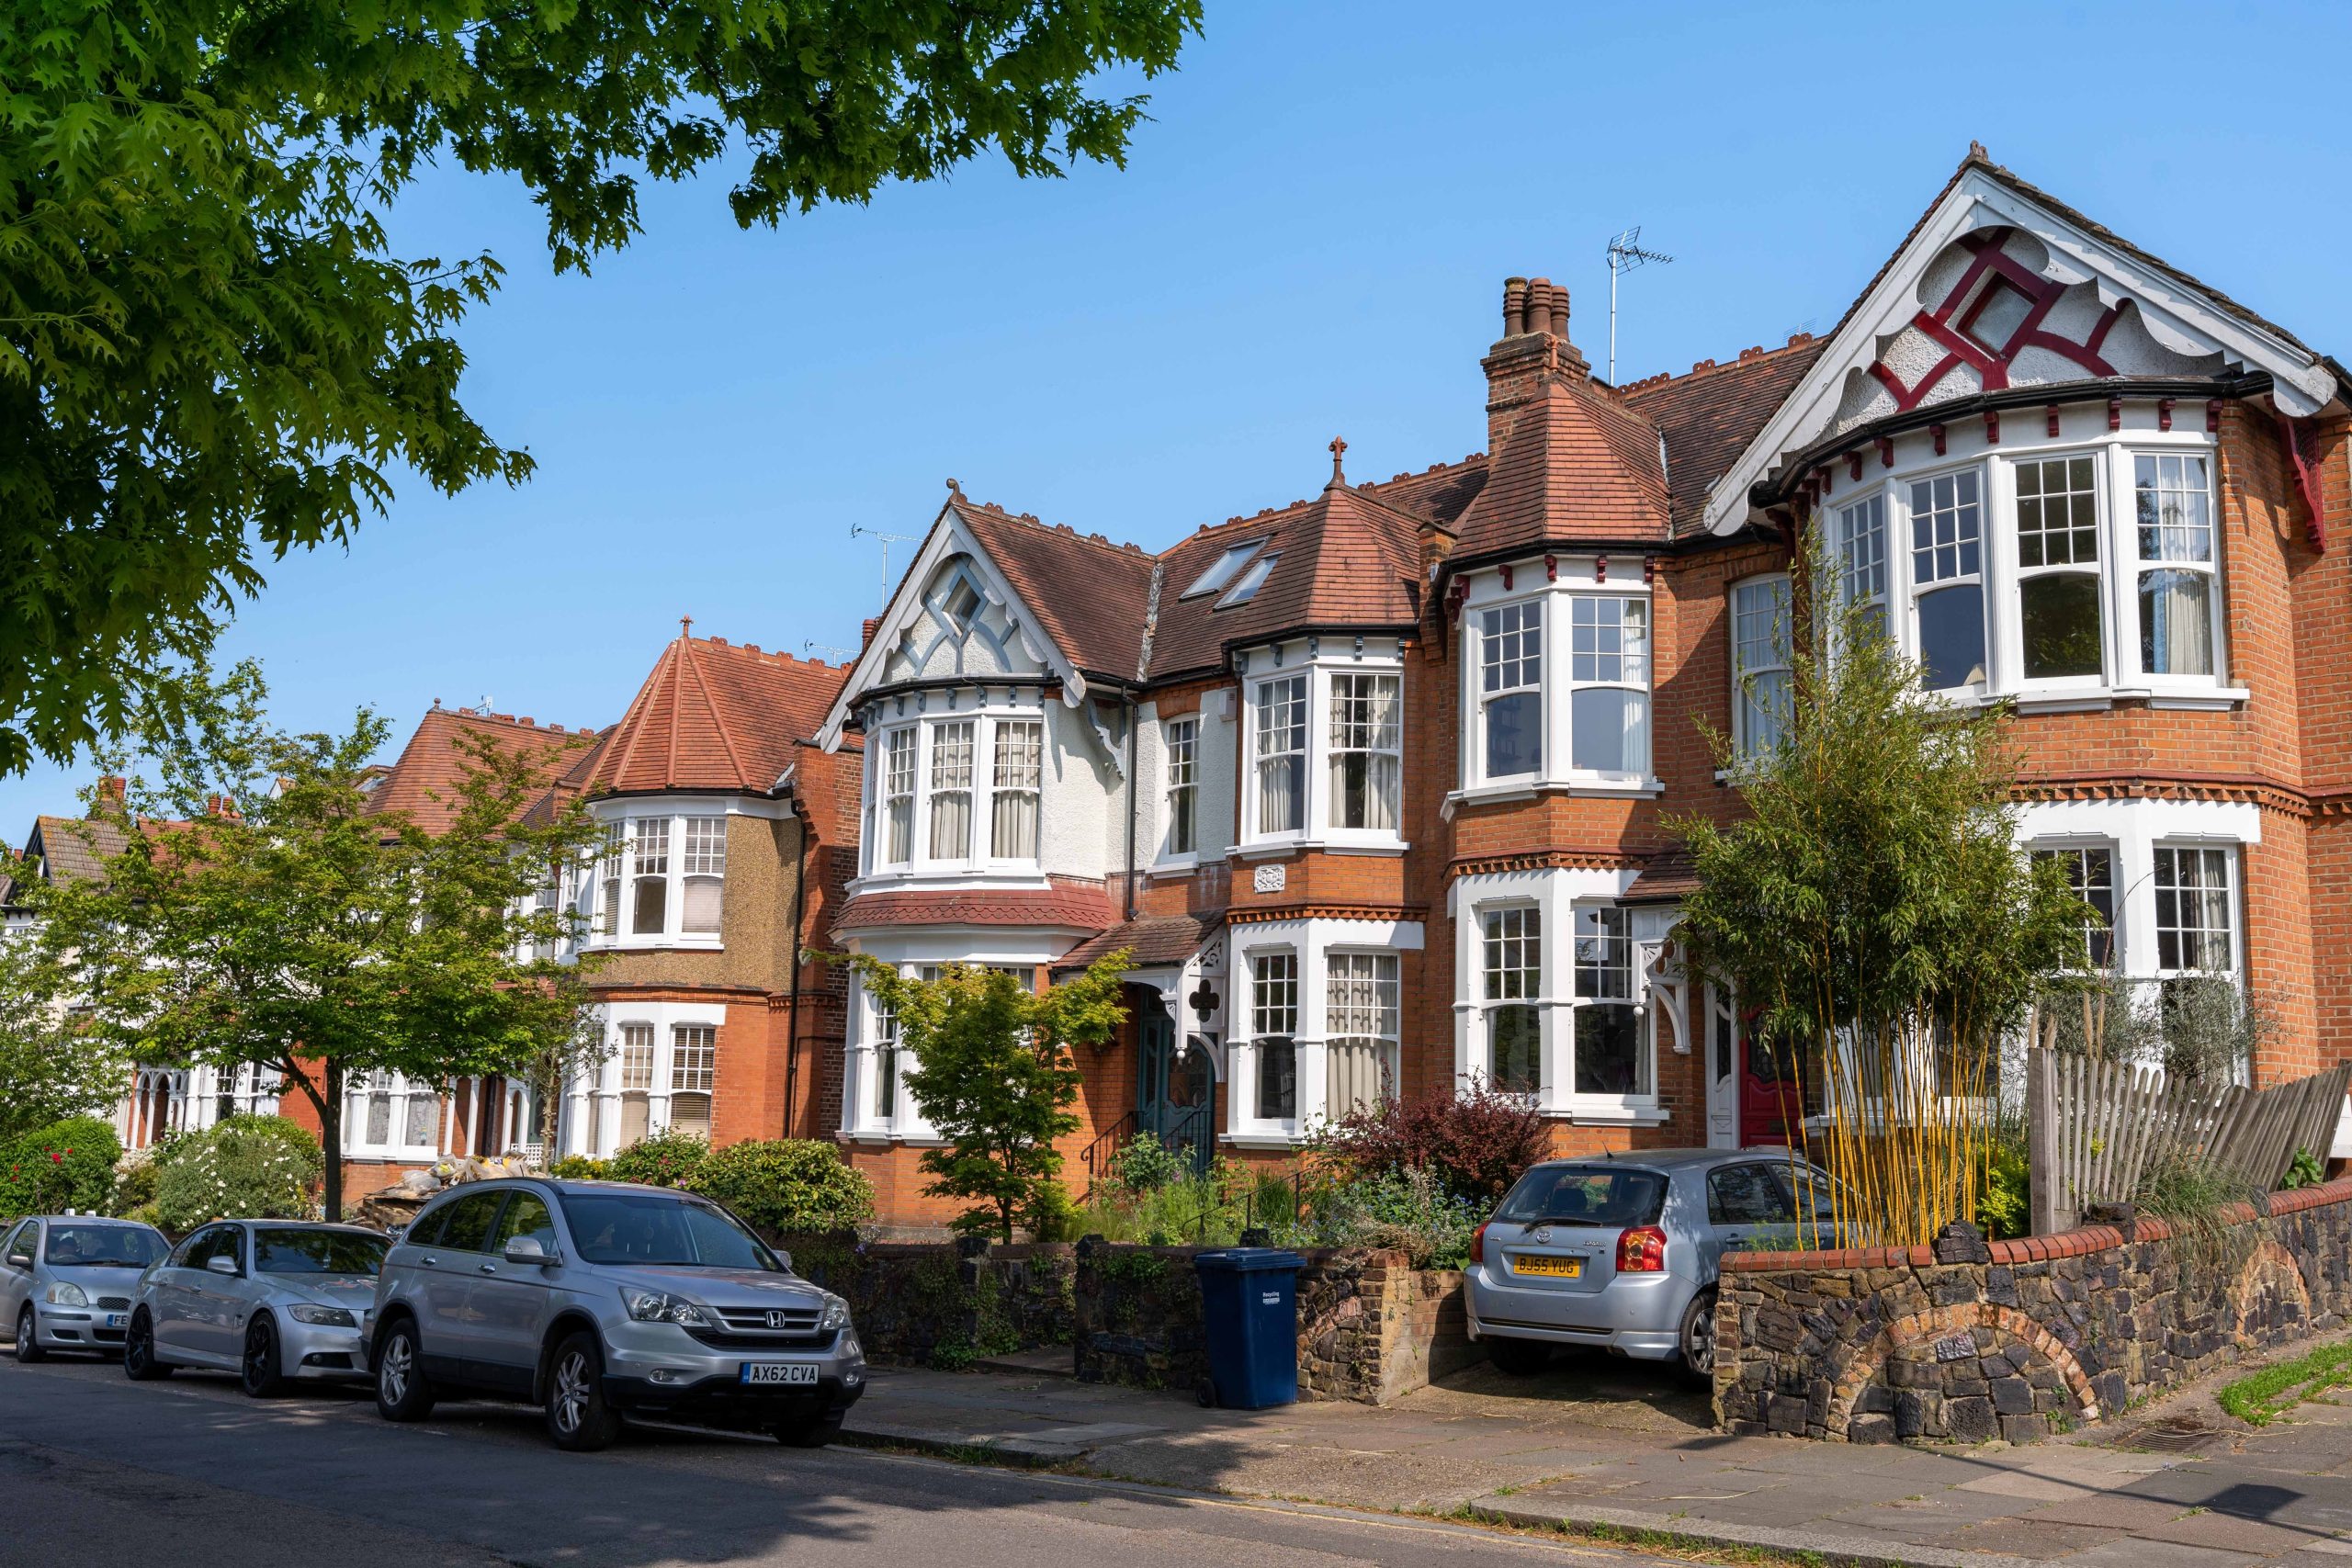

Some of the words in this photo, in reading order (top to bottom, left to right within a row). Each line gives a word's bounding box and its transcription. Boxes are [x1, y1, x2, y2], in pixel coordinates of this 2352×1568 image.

[1519, 1258, 1548, 1272] BJ55
[1552, 1259, 1575, 1274] YUG
[114, 1314, 127, 1325] FE
[752, 1366, 787, 1382] AX62
[791, 1367, 816, 1382] CVA
